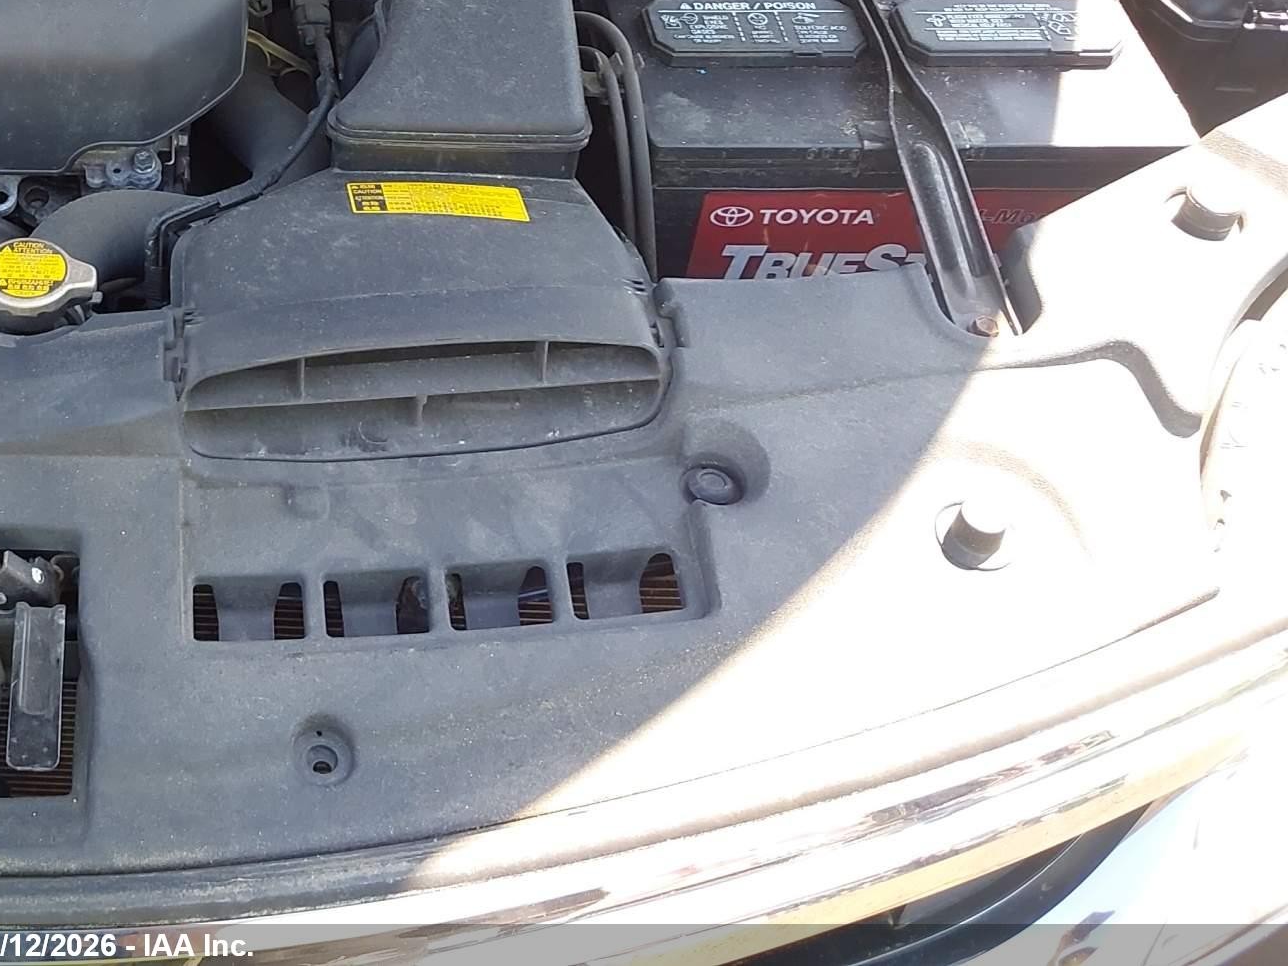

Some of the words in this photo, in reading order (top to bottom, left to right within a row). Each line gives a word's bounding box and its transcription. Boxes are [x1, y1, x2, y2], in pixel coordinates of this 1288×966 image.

[693, 2, 750, 11] DANGER
[764, 2, 817, 11] POISON
[759, 209, 875, 225] TOYOTA
